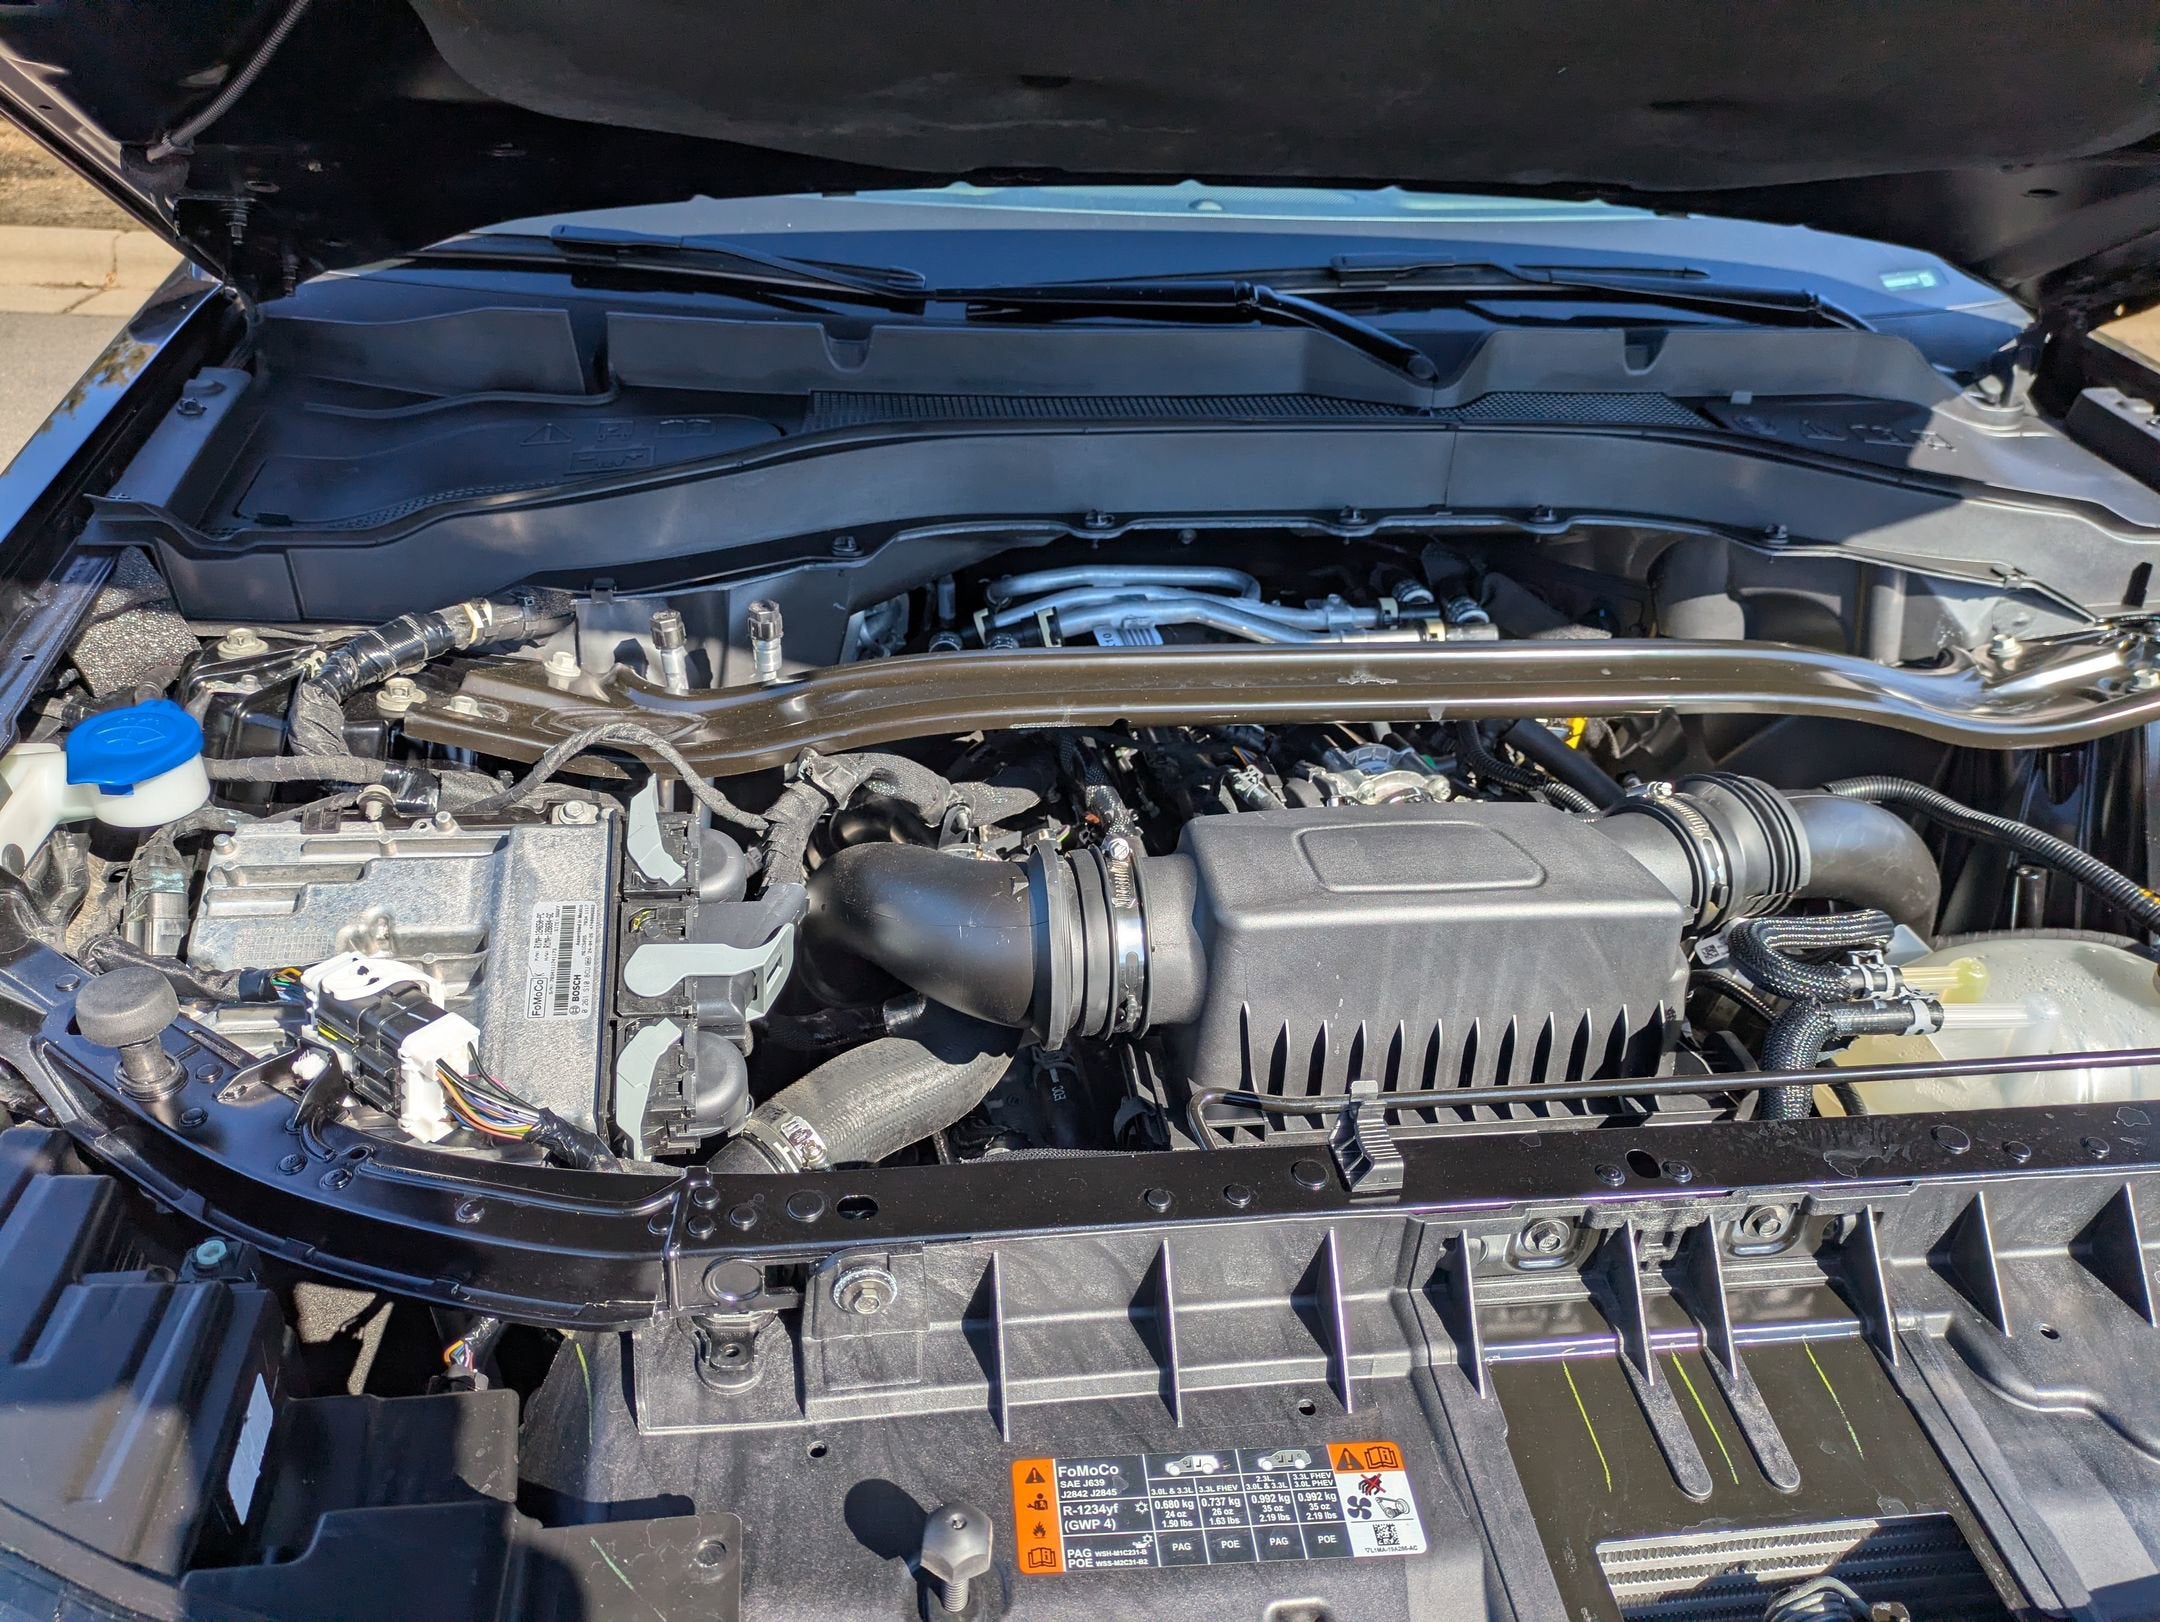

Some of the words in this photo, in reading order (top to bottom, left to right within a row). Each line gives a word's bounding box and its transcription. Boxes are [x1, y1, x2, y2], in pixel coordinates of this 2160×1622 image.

[571, 974, 582, 1002] BOSCH
[532, 979, 544, 1016] FoMoCo
[1058, 1464, 1119, 1478] FoMoCo
[1293, 1473, 1309, 1481] 3.3L
[1311, 1472, 1332, 1480] FHEV
[1060, 1480, 1080, 1488] SAE
[1083, 1479, 1105, 1488] J639
[1246, 1482, 1263, 1490] 3.0L
[1271, 1480, 1288, 1489] 3.3L
[1294, 1480, 1311, 1488] 3.0L
[1312, 1479, 1334, 1487] PHEV
[1151, 1488, 1169, 1496] 3.0L
[1170, 1487, 1176, 1495] &
[1177, 1486, 1193, 1495] 3.3L
[1198, 1485, 1215, 1493] 3.3L
[1216, 1484, 1238, 1492] FHEV
[1061, 1490, 1088, 1499] J2842
[1090, 1488, 1117, 1498] J2845
[1297, 1492, 1323, 1502] 0.992
[1324, 1491, 1337, 1503] kg
[1201, 1497, 1226, 1508] 0.737
[1228, 1495, 1241, 1508] kg
[1251, 1494, 1276, 1504] 0.992
[1277, 1493, 1291, 1505] kg
[1154, 1499, 1180, 1510] 0.680
[1182, 1498, 1194, 1511] kg
[1262, 1505, 1272, 1513] 35
[1308, 1503, 1319, 1511] 35
[1320, 1503, 1331, 1511] oz
[1063, 1503, 1119, 1516] R-1234yf
[1212, 1508, 1222, 1516] 26
[1224, 1508, 1234, 1516] oz
[1165, 1510, 1175, 1519] 24
[1176, 1510, 1187, 1518] oz
[1259, 1513, 1277, 1522] 2.19
[1278, 1513, 1291, 1521] lbs
[1306, 1512, 1324, 1521] 2.19
[1325, 1511, 1338, 1520] lbs
[1064, 1520, 1101, 1531] (GWP
[1103, 1518, 1116, 1531] 4)
[1162, 1519, 1178, 1528] 1.50
[1180, 1519, 1193, 1527] lbs
[1209, 1517, 1226, 1526] 1.63
[1227, 1517, 1240, 1525] lbs
[1269, 1537, 1289, 1546] PAG
[1317, 1535, 1337, 1544] POE
[1172, 1542, 1192, 1551] PAG
[1221, 1540, 1240, 1549] POE
[1067, 1549, 1092, 1559] PAG
[1068, 1558, 1094, 1568] POE
